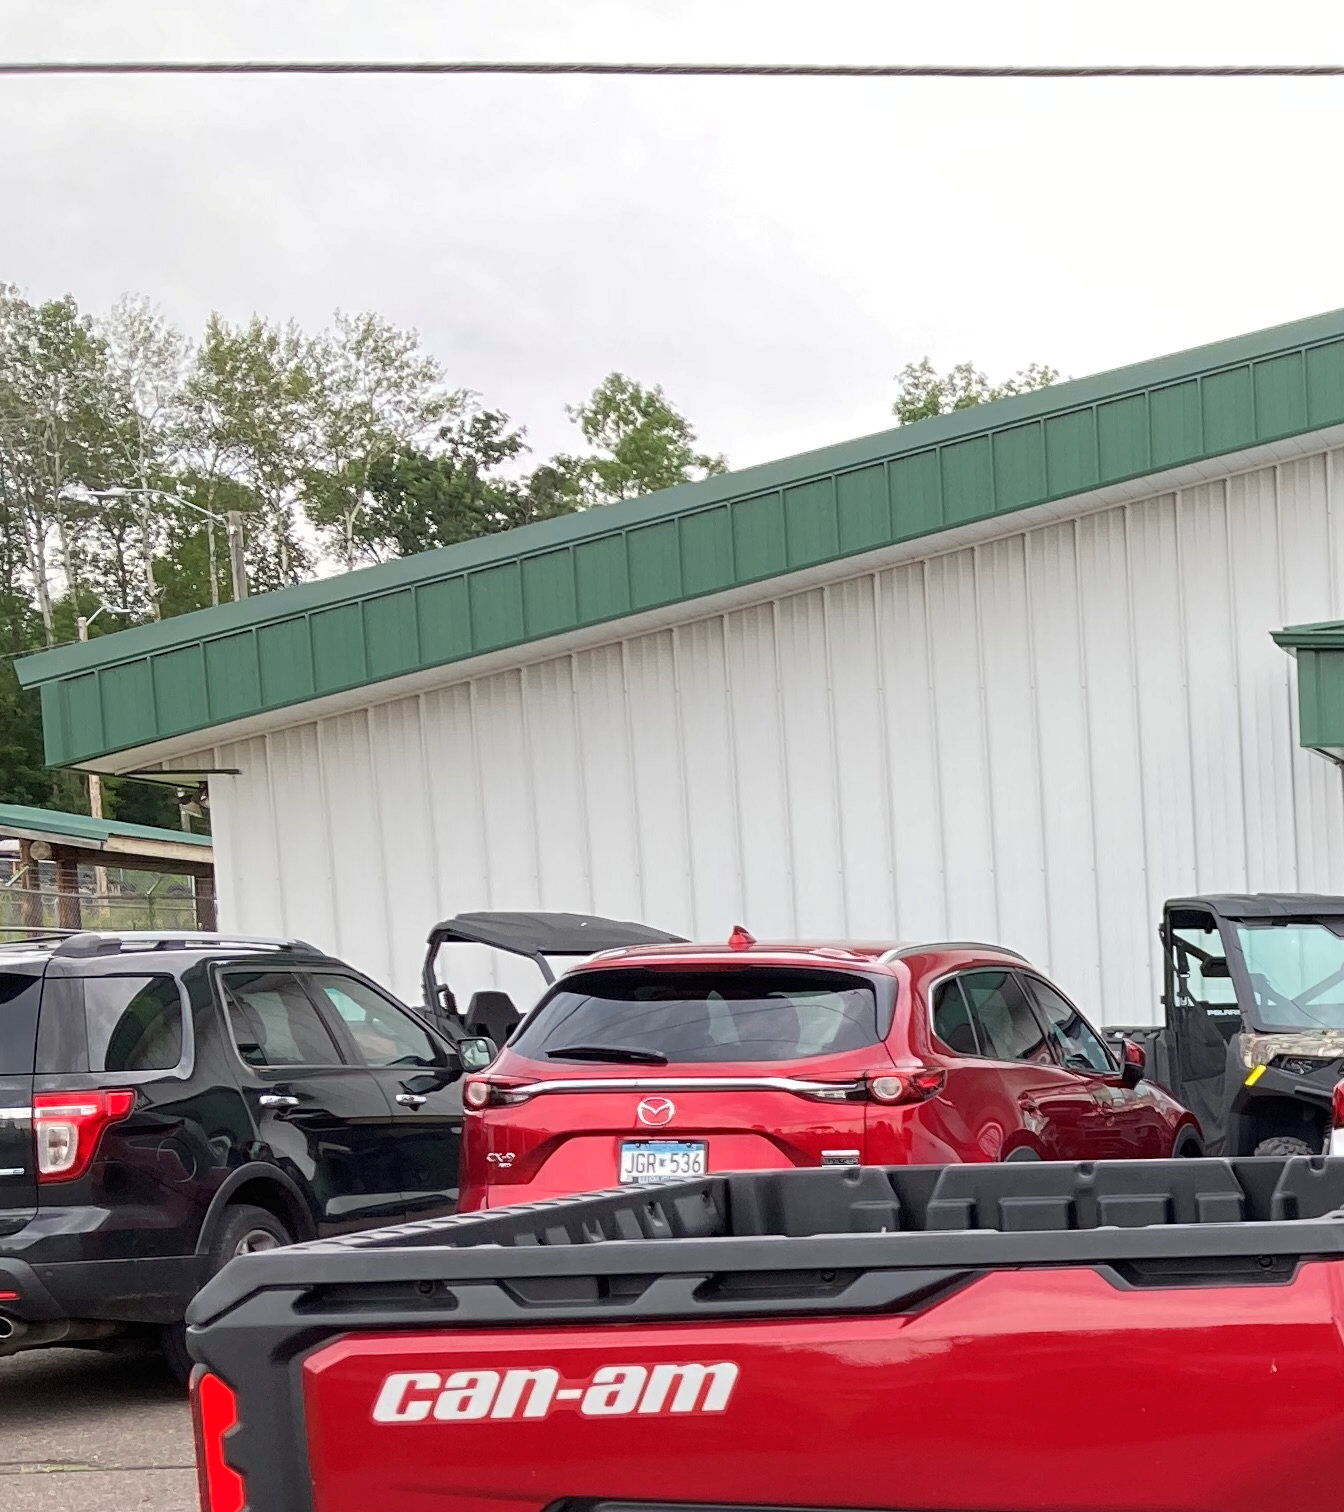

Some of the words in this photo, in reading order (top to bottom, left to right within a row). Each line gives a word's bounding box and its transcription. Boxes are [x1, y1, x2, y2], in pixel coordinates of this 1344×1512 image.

[624, 1153, 656, 1174] JGR
[670, 1152, 701, 1173] 536
[371, 1361, 739, 1423] can-am
